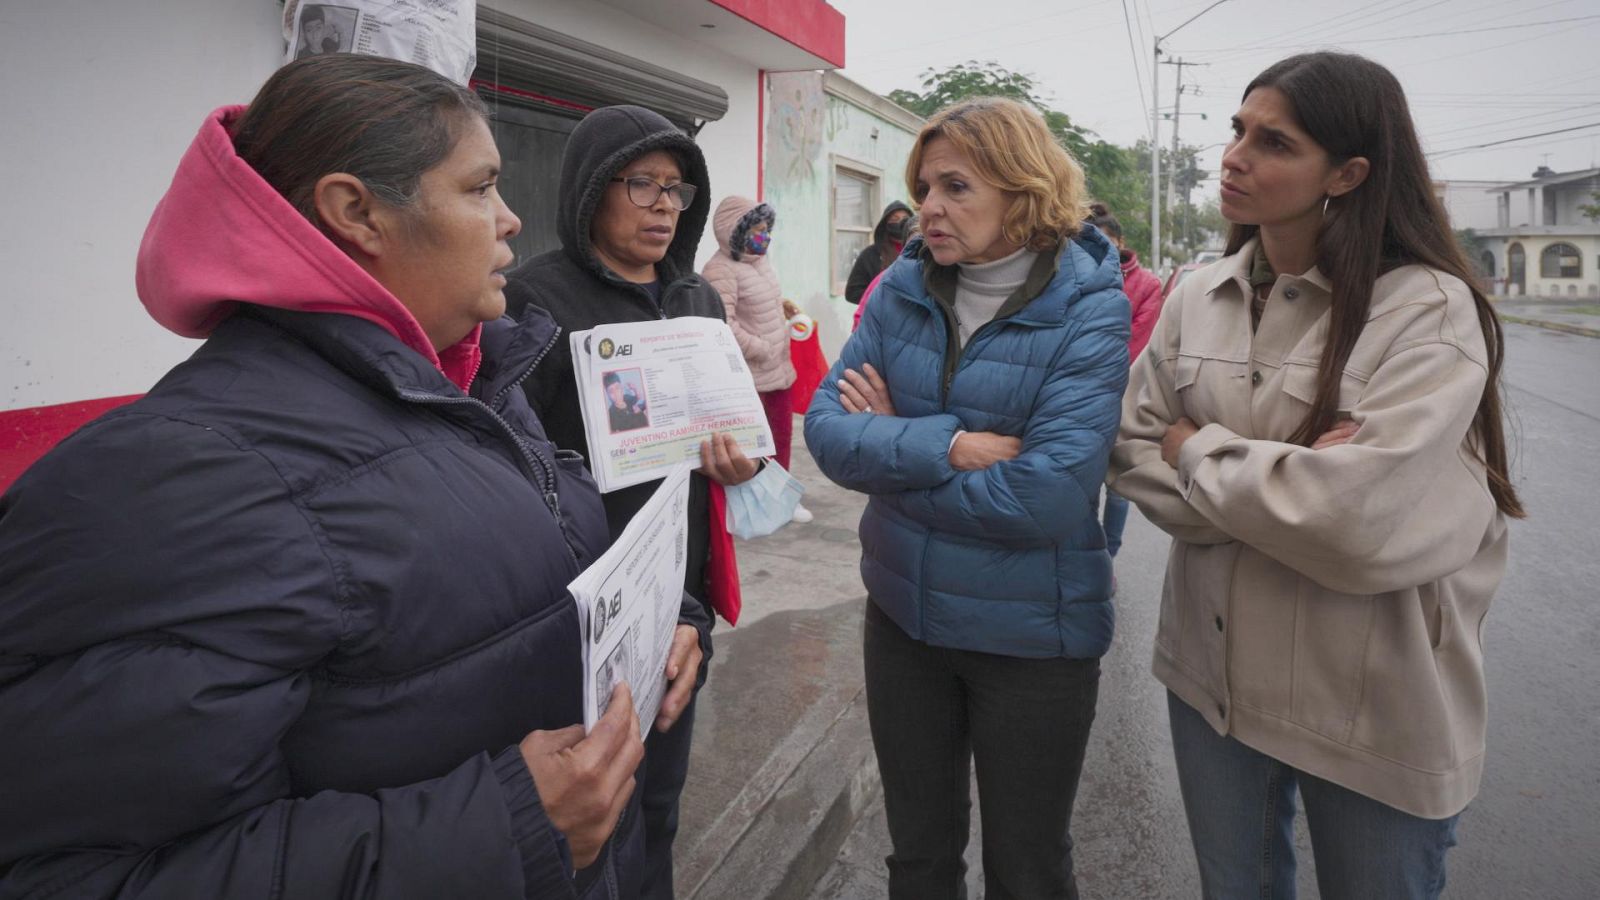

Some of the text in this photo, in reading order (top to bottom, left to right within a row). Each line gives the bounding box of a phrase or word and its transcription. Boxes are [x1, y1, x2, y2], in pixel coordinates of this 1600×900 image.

[615, 344, 632, 357] AEI
[619, 431, 668, 448] JUVENTINO
[606, 587, 622, 627] AEI
